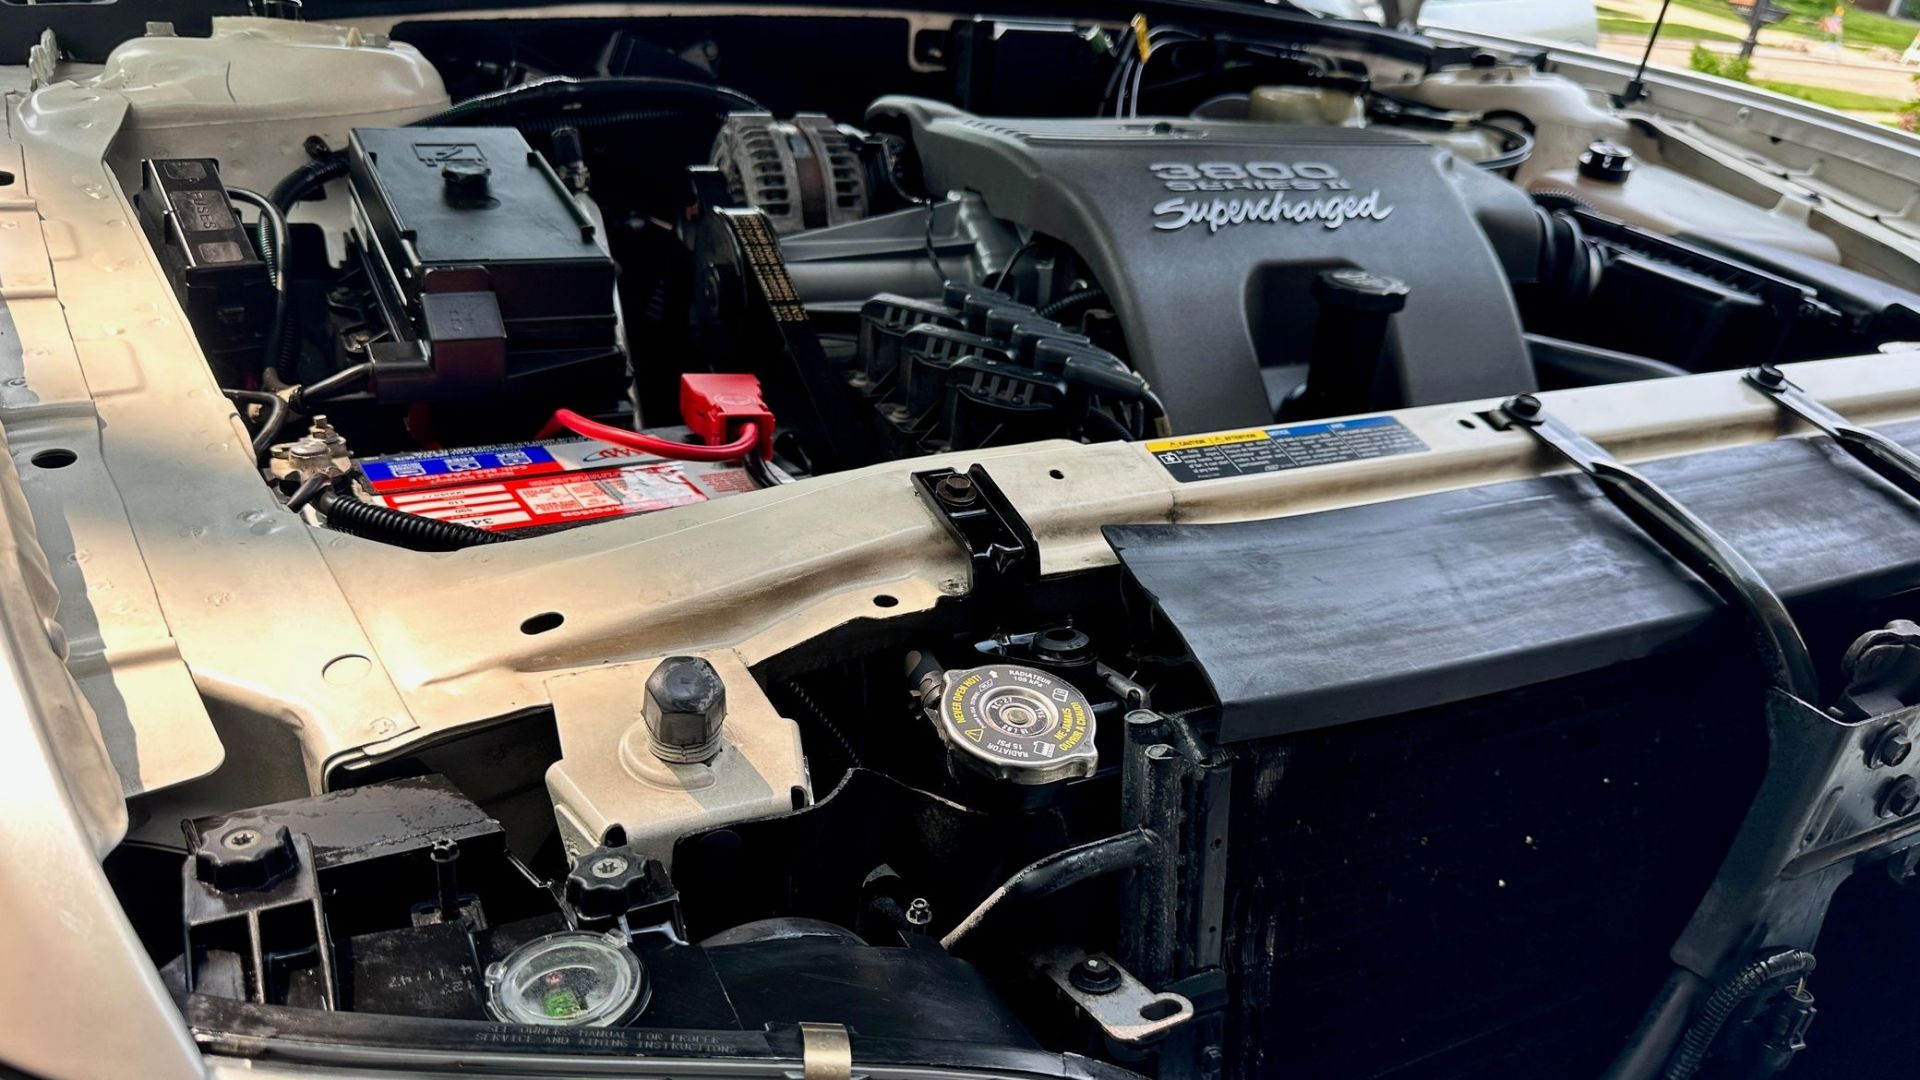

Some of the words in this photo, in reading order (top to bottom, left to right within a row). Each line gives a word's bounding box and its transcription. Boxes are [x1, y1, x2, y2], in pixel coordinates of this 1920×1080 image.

[1149, 161, 1340, 180] 3800
[192, 192, 217, 229] FUSES
[1152, 188, 1396, 233] Supercharged
[963, 674, 983, 688] HOT!
[1008, 669, 1052, 685] RADIATEUR
[1014, 675, 1028, 683] 105
[1028, 679, 1043, 688] kPa
[953, 684, 969, 702] OPEN
[952, 702, 967, 724] NEVER
[1054, 730, 1068, 741] NE
[1061, 707, 1073, 733] JAMAIS
[996, 739, 1012, 748] PSI
[1059, 729, 1084, 751] OUVRIR
[986, 742, 1029, 758] RADIATOR
[475, 1032, 531, 1043] SERVICE
[546, 1036, 570, 1045] AND
[578, 1038, 629, 1048] AIMING
[638, 1039, 737, 1053] INSTRUCTIONS
[488, 1025, 508, 1033] SEE
[579, 1029, 625, 1040] MANUAL
[638, 1031, 664, 1041] FOR
[671, 1033, 722, 1044] PROPER
